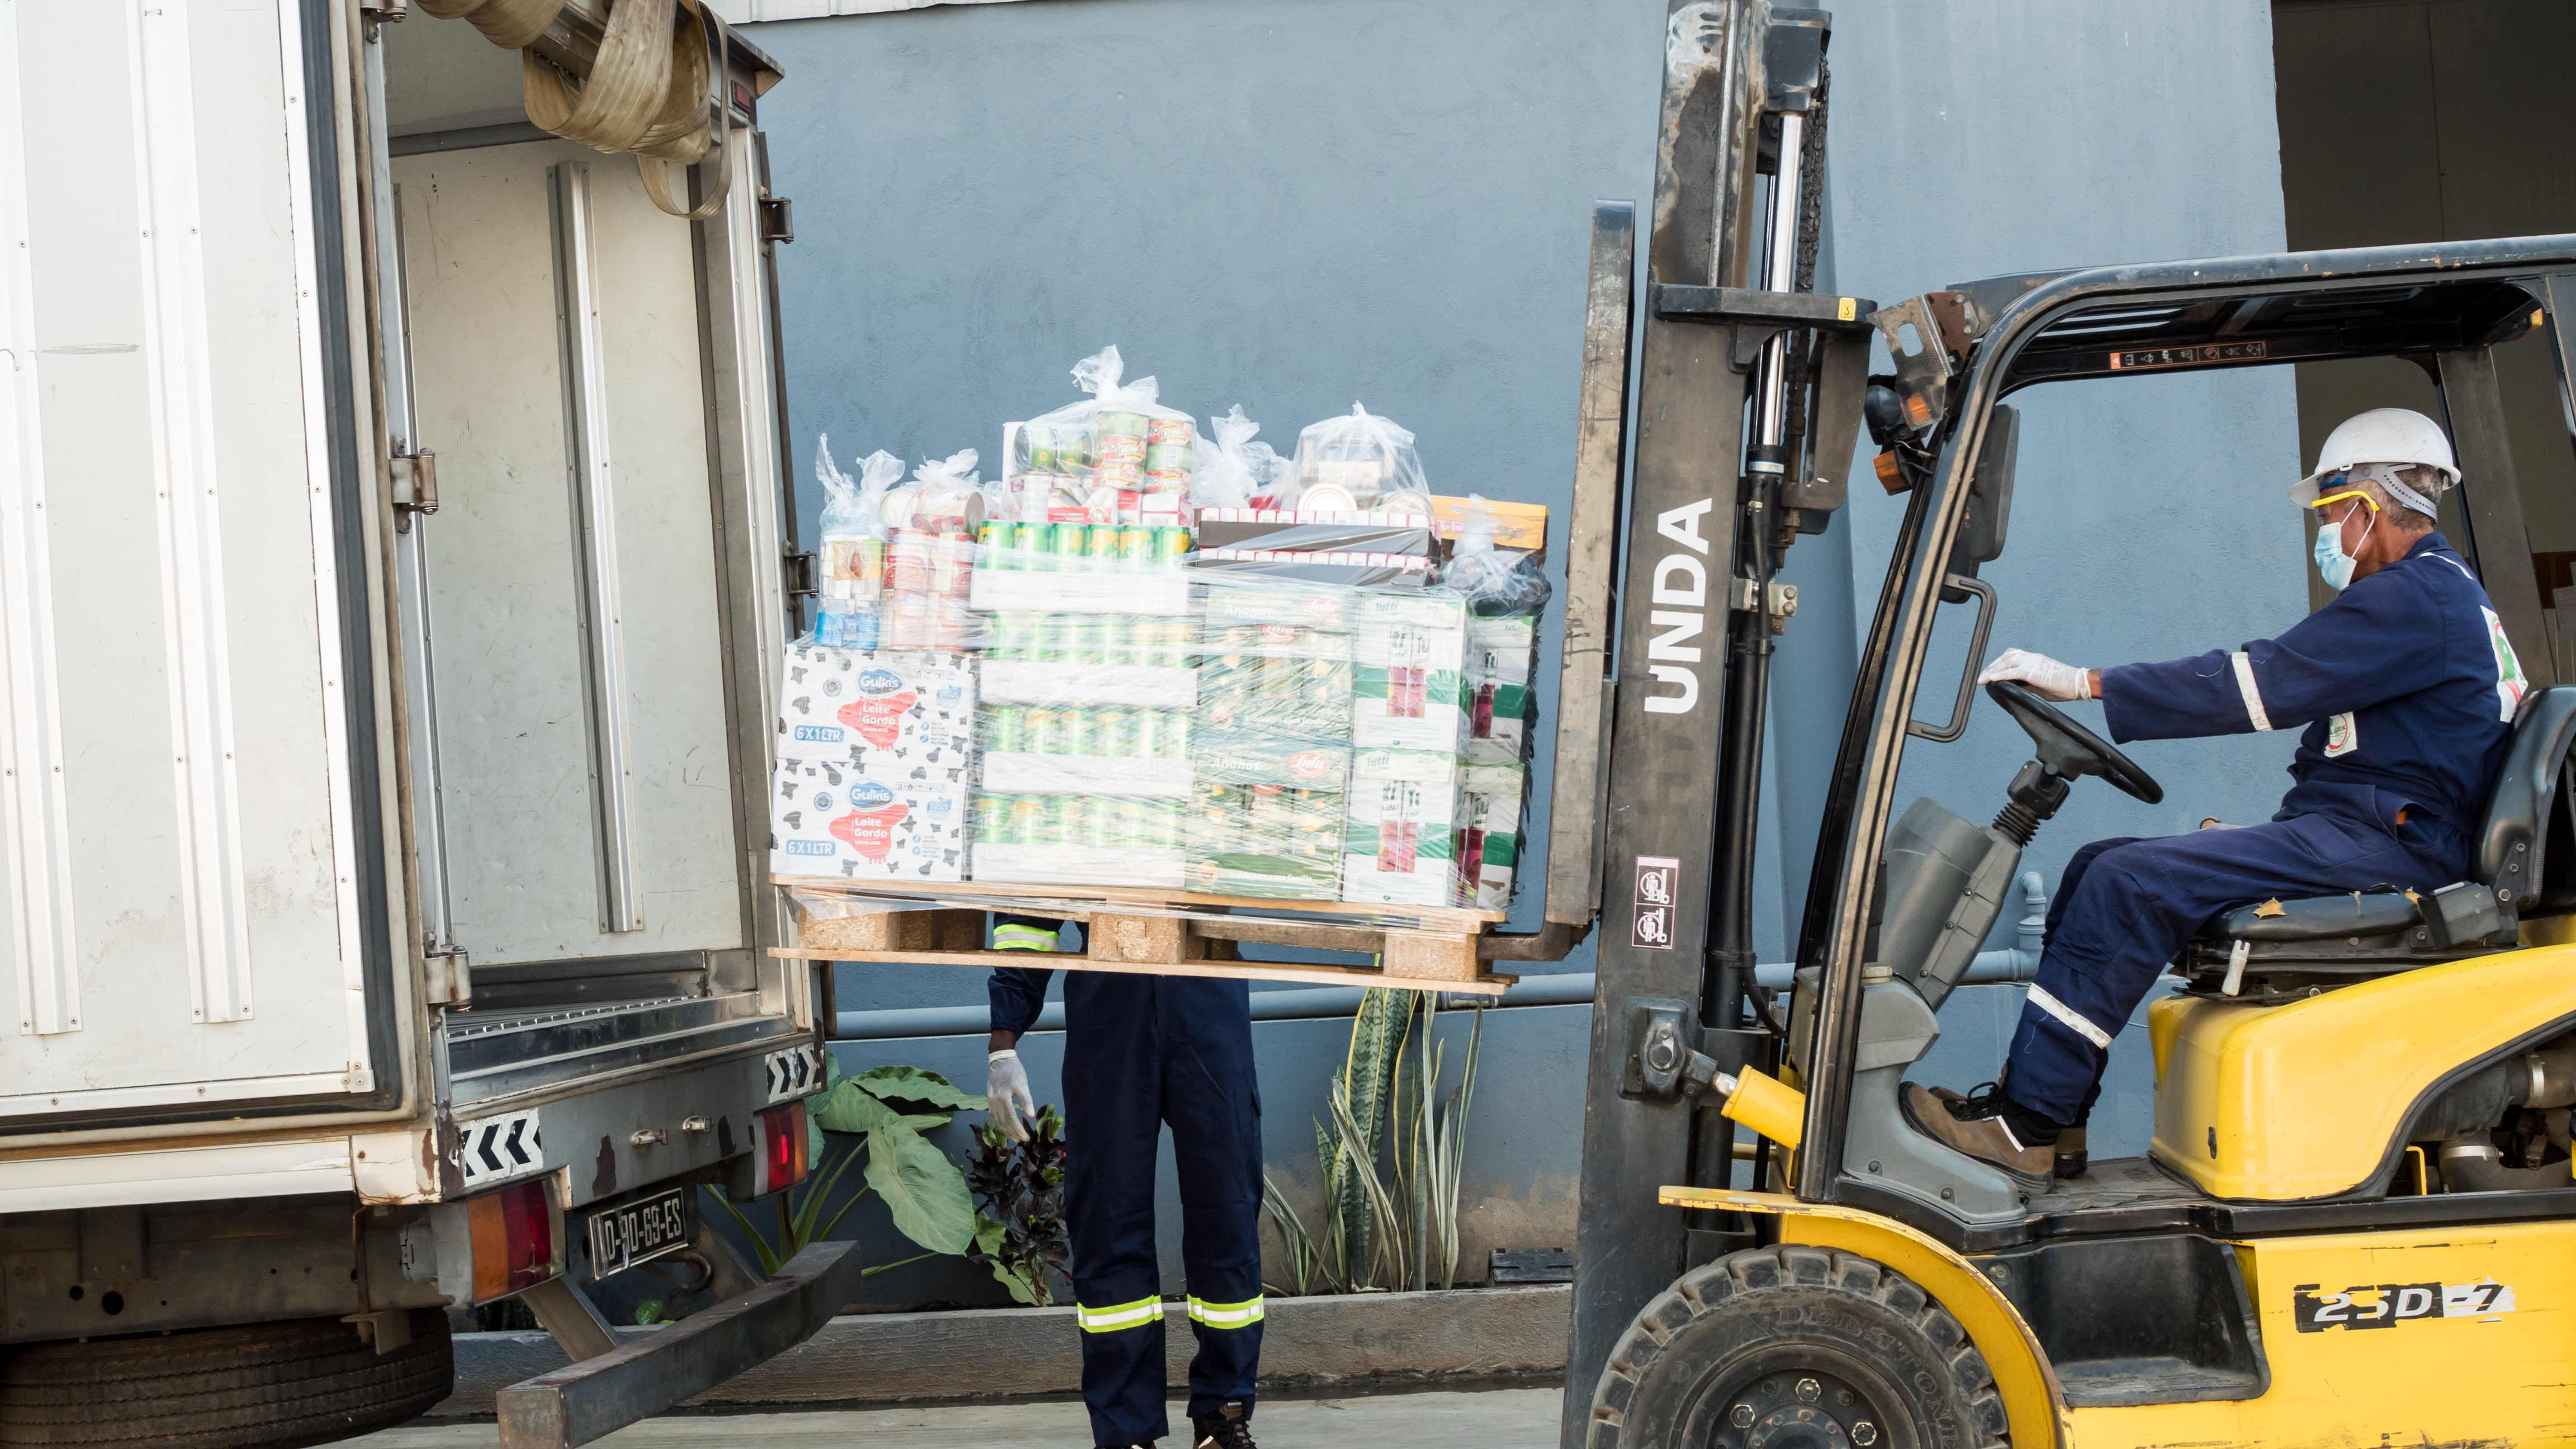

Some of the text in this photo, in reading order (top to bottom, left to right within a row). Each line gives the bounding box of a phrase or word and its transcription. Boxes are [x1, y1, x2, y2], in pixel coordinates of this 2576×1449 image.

[1224, 604, 1273, 616] Ananas
[1304, 599, 1337, 616] Lulu
[1375, 599, 1399, 612] Tutti
[1644, 498, 1712, 714] UNDA
[1262, 650, 1292, 659] Ananas
[861, 675, 899, 688] Gulkis
[863, 704, 890, 714] Leite
[862, 715, 896, 726] Gordo
[797, 727, 804, 739] 6
[1211, 757, 1260, 770] Ananas
[1292, 755, 1324, 773] Lulu
[1367, 753, 1390, 766] Tutti
[851, 788, 890, 801] Gulkis
[1251, 803, 1281, 811] Ananas
[855, 817, 882, 826] Leite
[854, 828, 888, 838] Gordo
[788, 841, 795, 853] 6
